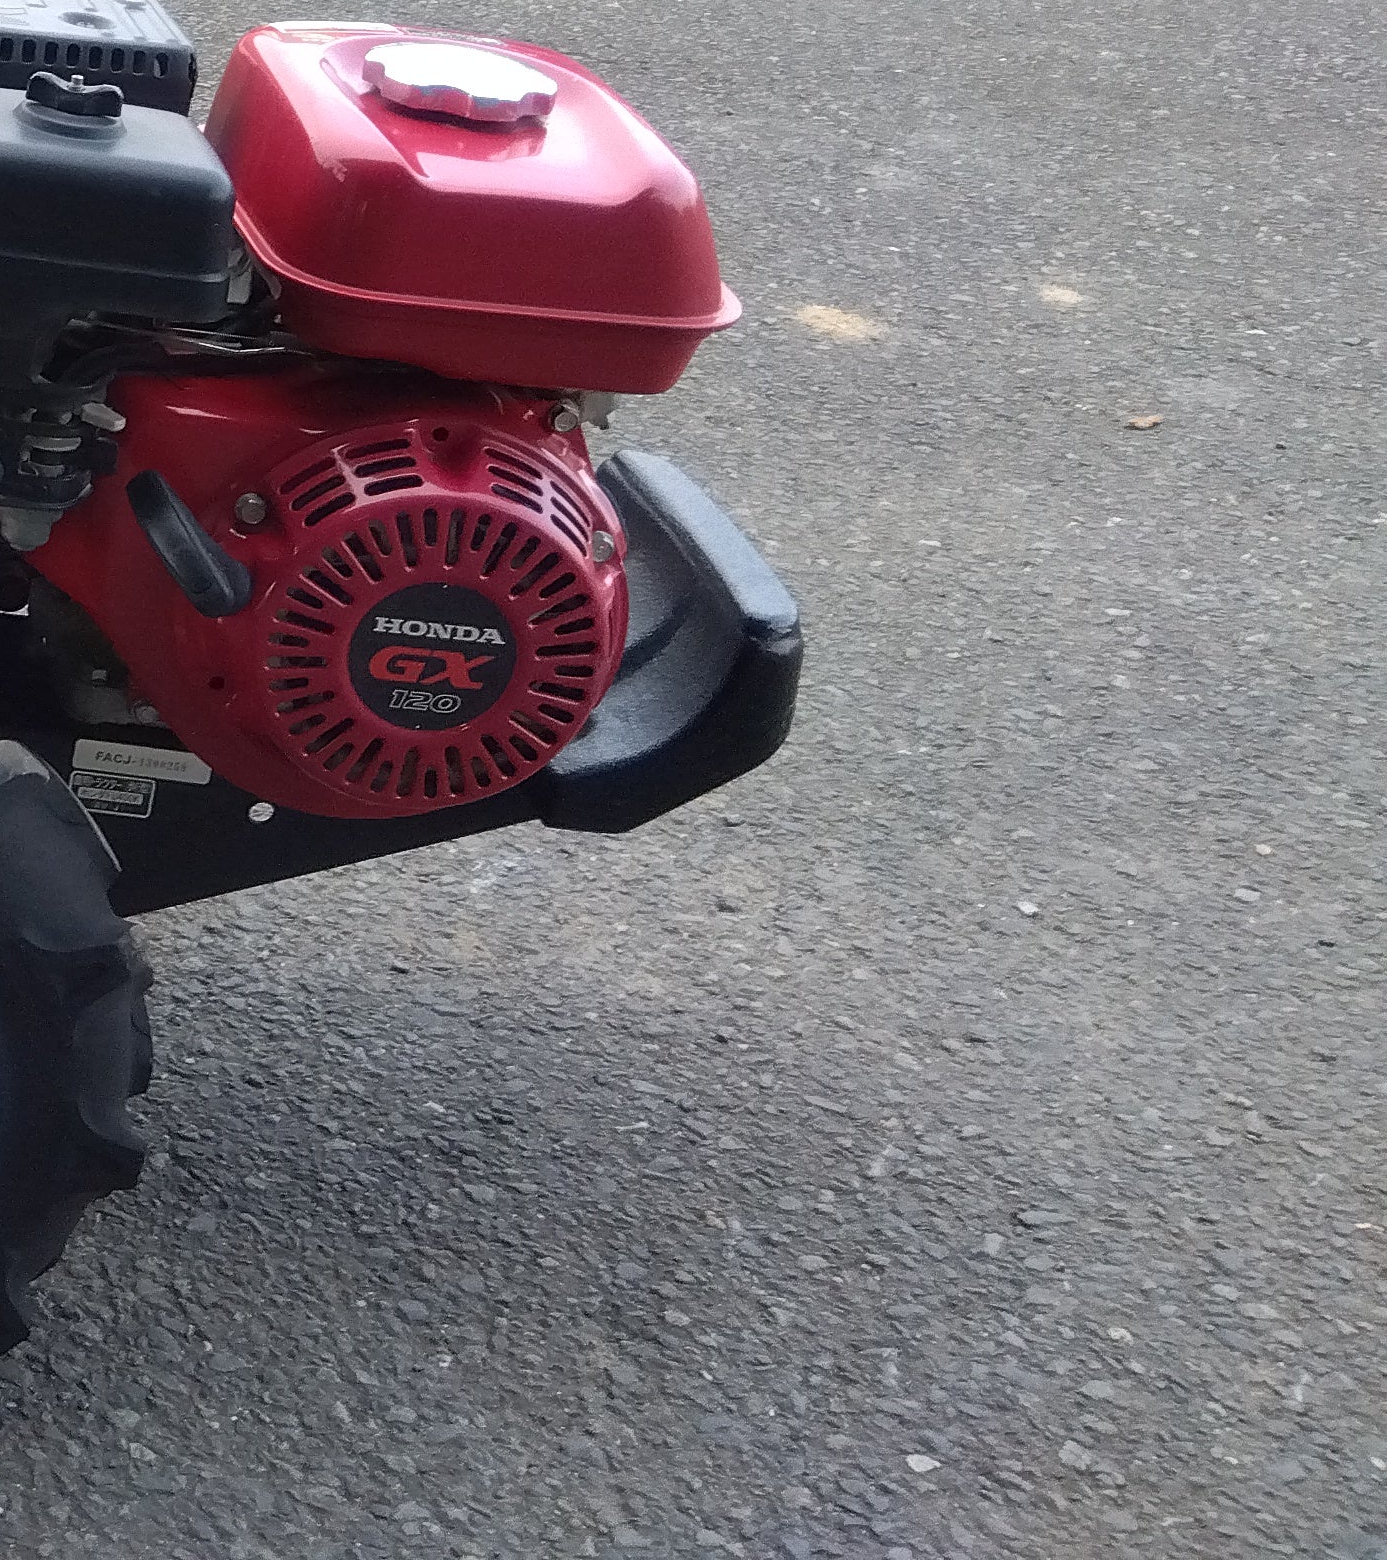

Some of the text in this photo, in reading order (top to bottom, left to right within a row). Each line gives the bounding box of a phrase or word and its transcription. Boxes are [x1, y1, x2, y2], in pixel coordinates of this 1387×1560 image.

[372, 616, 506, 645] HONDA
[368, 645, 495, 689] GX
[388, 689, 462, 714] 120
